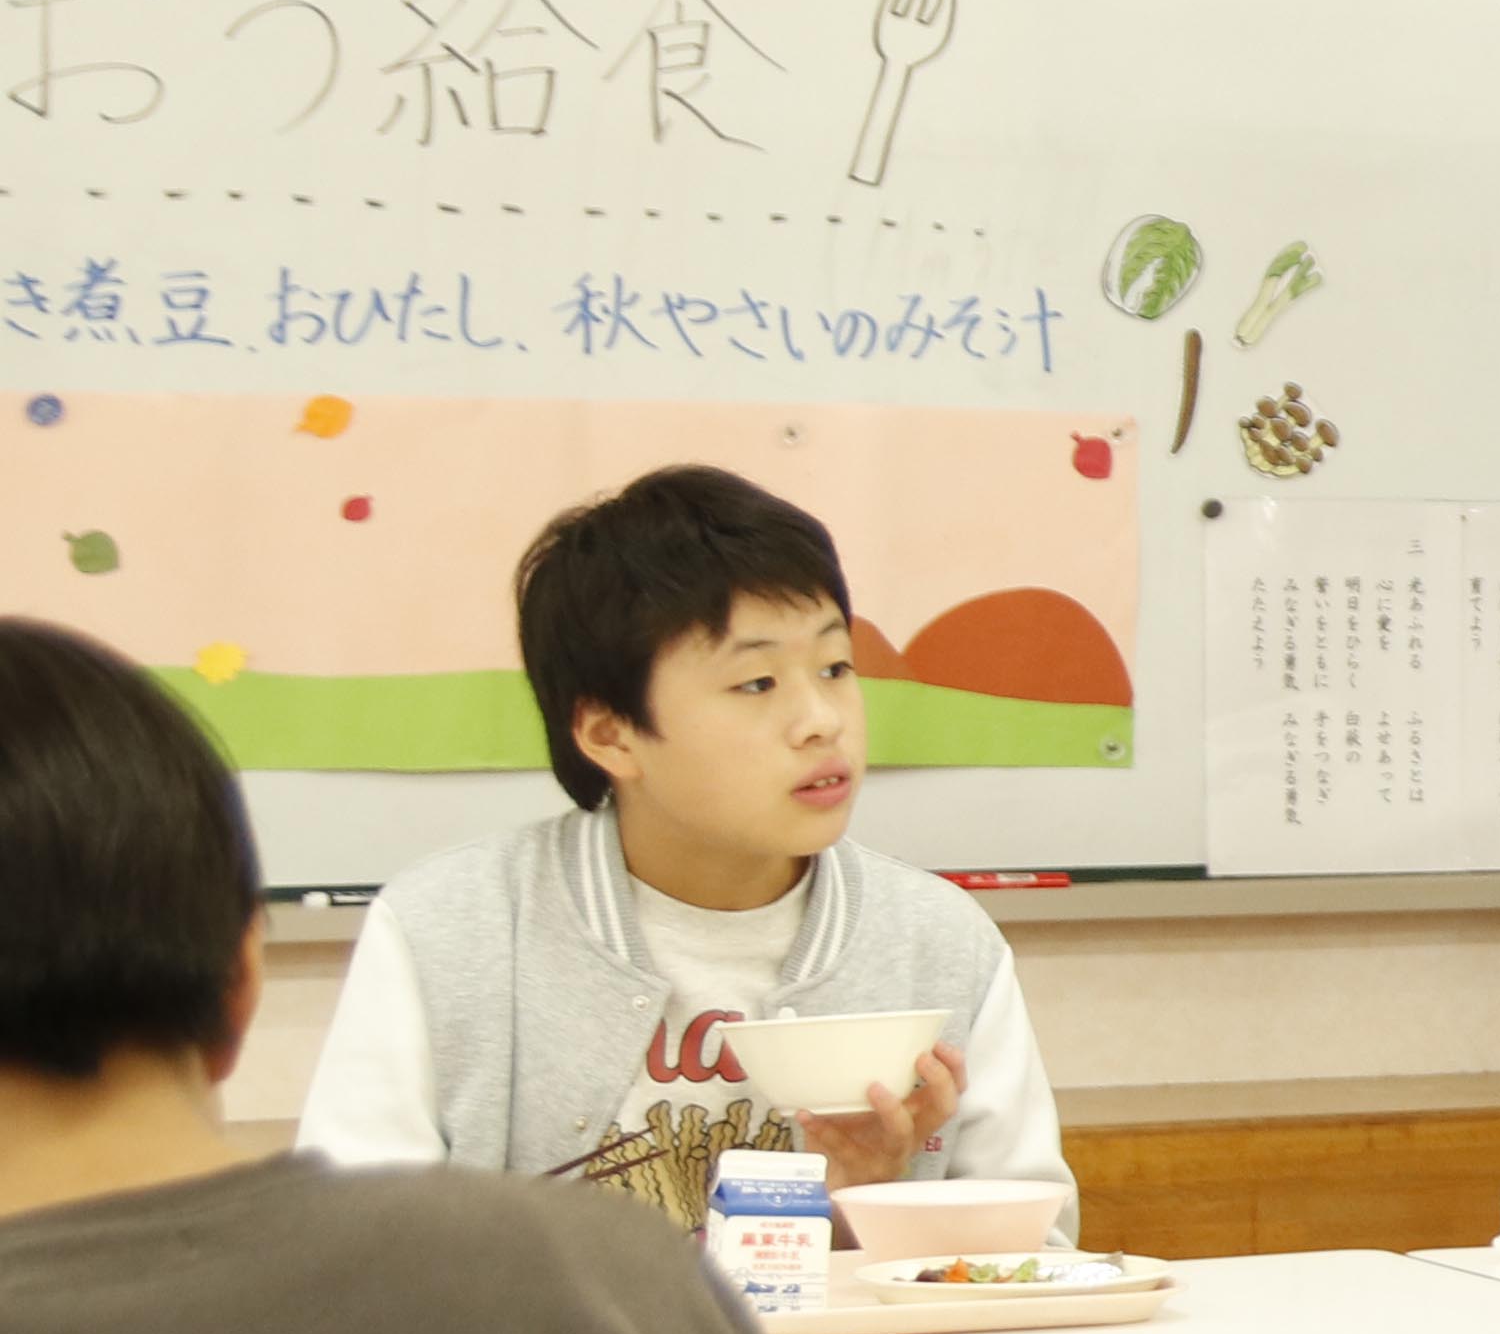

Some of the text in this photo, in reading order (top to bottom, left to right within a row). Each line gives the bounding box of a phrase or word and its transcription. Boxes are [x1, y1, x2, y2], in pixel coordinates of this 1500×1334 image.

[1407, 539, 1425, 555] 三
[1250, 576, 1268, 670] たたえよう
[1375, 578, 1395, 652] 心に愛を
[1467, 576, 1485, 652] 育てよう
[1281, 577, 1303, 826] みなぎる勇気 みなぎる勇気
[1312, 709, 1332, 805] 手をつなぎ
[1405, 710, 1425, 804] ふるさとは
